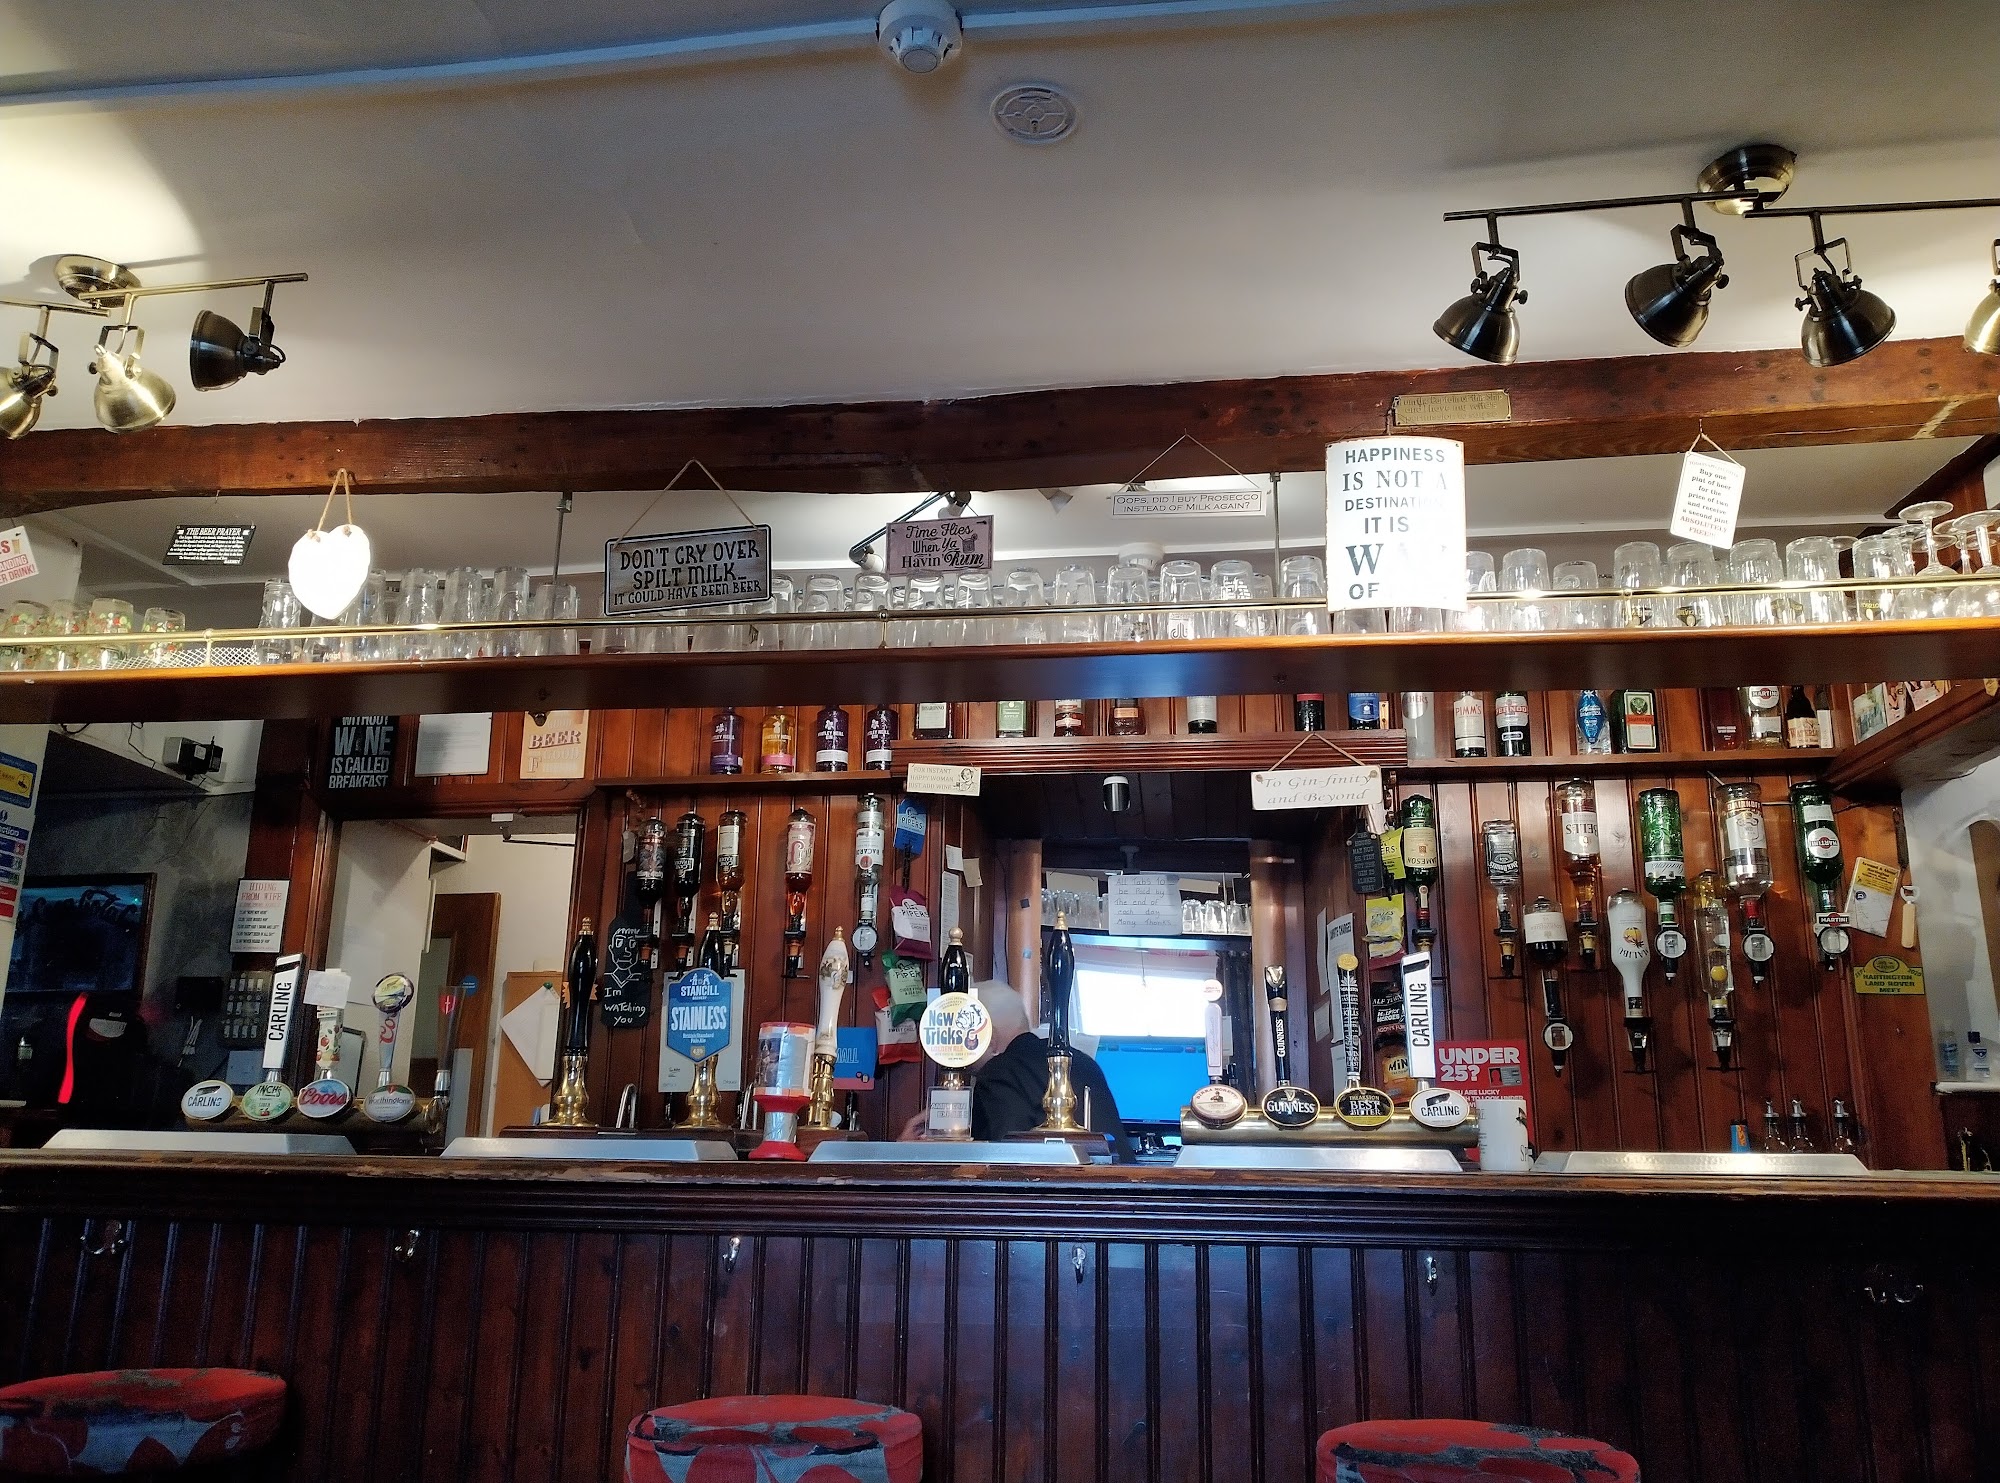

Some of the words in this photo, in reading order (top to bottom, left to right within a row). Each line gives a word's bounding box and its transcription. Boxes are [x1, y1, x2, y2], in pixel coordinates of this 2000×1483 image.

[1345, 447, 1445, 464] HAPPINESS
[1699, 468, 1713, 477] Buy
[1342, 471, 1364, 491] IS
[1376, 470, 1423, 489] NOT
[1437, 472, 1447, 490] A
[1691, 476, 1706, 484] pint
[1716, 481, 1732, 490] beer
[1177, 495, 1198, 503] BUY
[1200, 493, 1259, 502] PROSECCO
[1688, 492, 1706, 501] price
[1123, 503, 1166, 512] INSTEAD
[1168, 503, 1182, 511] OF
[1185, 502, 1211, 511] MILK
[1213, 501, 1250, 510] AGAIN?
[1687, 501, 1701, 509] and
[1702, 505, 1727, 515] receive
[1688, 510, 1713, 520] second
[905, 525, 938, 539] Time
[940, 522, 974, 537] Flies
[1364, 517, 1382, 534] IT
[1390, 516, 1409, 533] IS
[1680, 515, 1728, 533] ABSOLUTELY
[912, 540, 940, 554] When
[941, 537, 958, 552] Ya
[620, 546, 669, 571] DON'T
[675, 543, 707, 565] CRY
[713, 540, 759, 562] OVER
[943, 549, 984, 568] Rum
[8, 563, 36, 581] DRINK!
[633, 566, 681, 590] SPILT
[614, 593, 624, 605] IT
[628, 589, 664, 605] COULD
[668, 585, 697, 600] HAVE
[701, 582, 728, 597] BEEN
[732, 580, 762, 594] BEER
[1349, 582, 1380, 600] OF
[1456, 704, 1481, 716] PIMM'S
[528, 730, 582, 749] BEER
[331, 757, 344, 773] IS
[344, 756, 390, 773] CALLED
[328, 775, 389, 789] BREAKFAST
[1264, 777, 1282, 788] To
[1288, 773, 1371, 790] Gin-finity
[1267, 792, 1298, 804] and
[1303, 788, 1371, 805] Beyond
[901, 816, 924, 829] PIPERS
[1406, 856, 1437, 865] JAMESON
[249, 883, 277, 891] HIDING
[1155, 889, 1165, 898] by
[241, 892, 260, 901] FROM
[264, 892, 282, 901] WIFE
[1132, 897, 1146, 905] end
[900, 909, 929, 919] PIPERS
[1145, 909, 1160, 919] day
[1116, 918, 1137, 928] Many
[1619, 946, 1649, 961] MALIBU
[680, 985, 719, 996] STANCILL
[268, 981, 292, 1042] CARLING
[671, 1006, 727, 1031] STAINLESS
[929, 1010, 954, 1026] New
[1411, 983, 1431, 1048] CARLING
[613, 1015, 633, 1026] You
[923, 1027, 963, 1045] Tricks
[1276, 1018, 1286, 1058] GUINNESS
[1438, 1047, 1521, 1064] UNDER
[1440, 1065, 1480, 1082] 25?
[256, 1085, 282, 1097] INCH'S
[300, 1087, 347, 1105] Coors
[1196, 1088, 1212, 1099] BIRRA
[187, 1096, 222, 1107] CARLING
[1266, 1100, 1316, 1114] GUINNESS
[1350, 1100, 1380, 1110] BEST
[1420, 1105, 1461, 1117] CARLING
